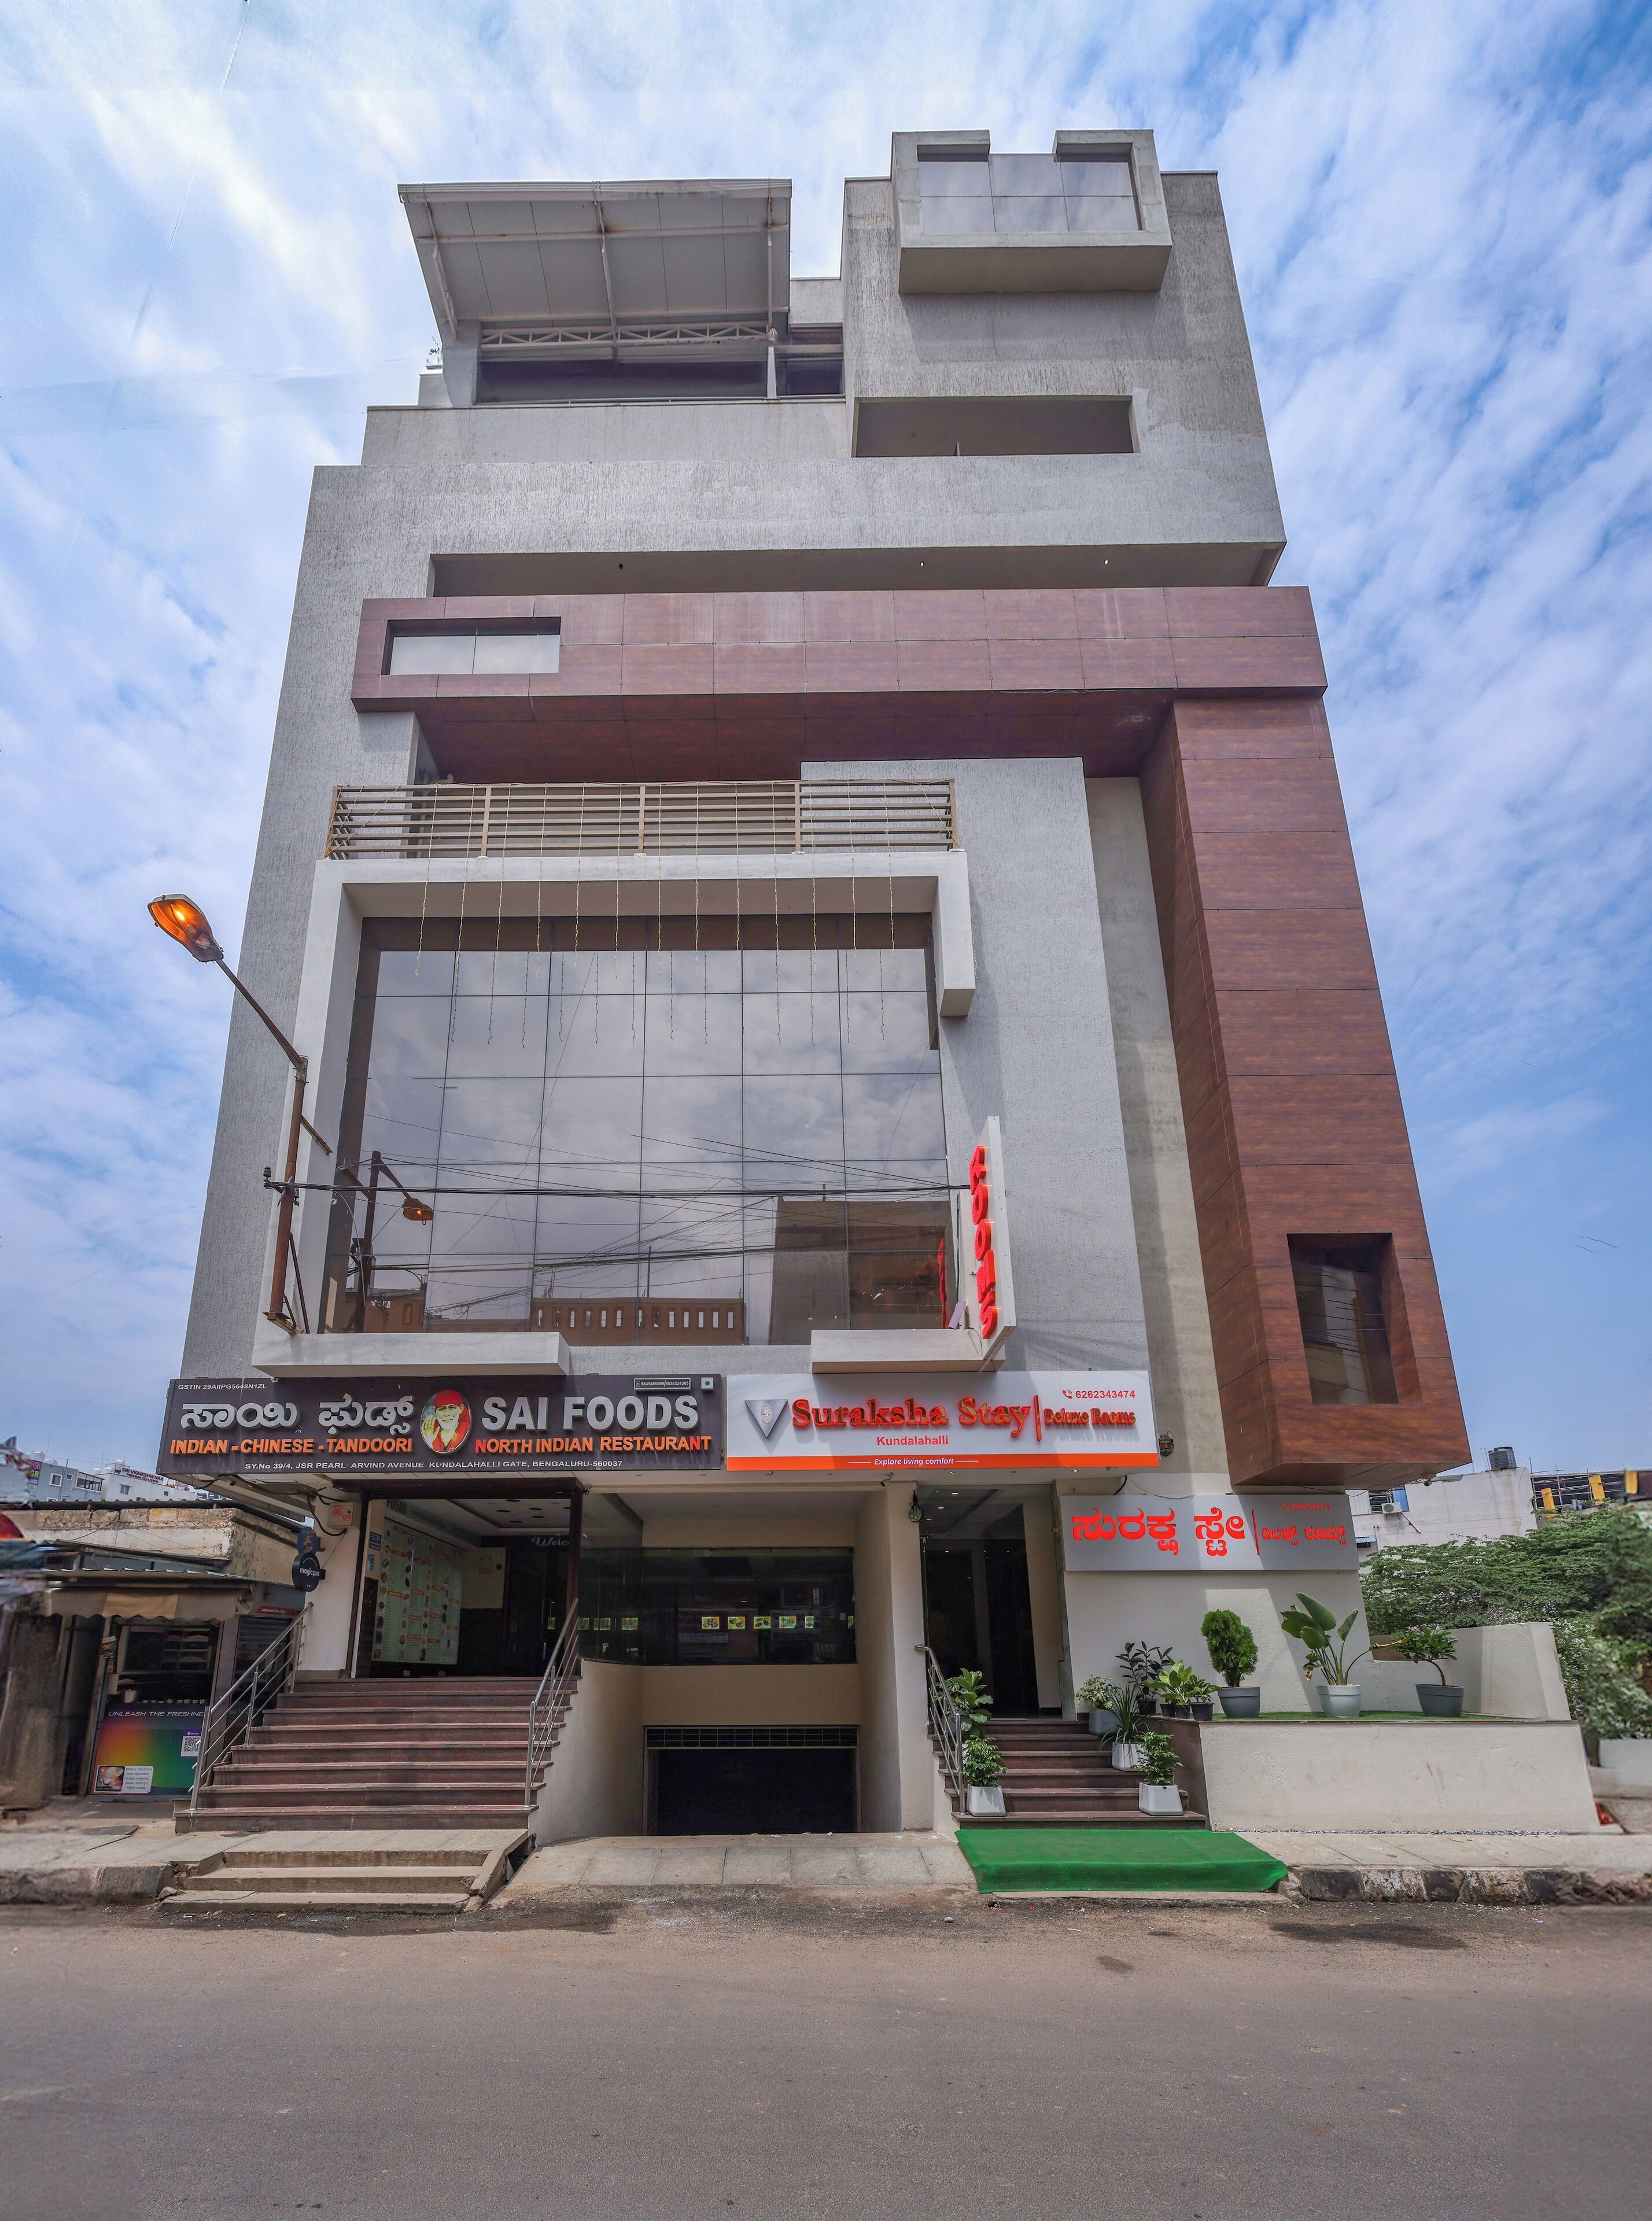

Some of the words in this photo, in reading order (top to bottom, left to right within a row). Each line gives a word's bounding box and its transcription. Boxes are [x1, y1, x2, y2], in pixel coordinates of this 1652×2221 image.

[969, 1145, 998, 1340] ROOMS
[1075, 1390, 1135, 1399] 6262343474
[180, 1402, 300, 1430] ಸಾಯಿ
[318, 1393, 414, 1436] ಫುಡ್ಸ್
[481, 1396, 549, 1432] SAI
[563, 1395, 699, 1432] FOODS
[792, 1397, 949, 1427] Suraksha
[958, 1397, 1031, 1438] Stay
[1043, 1407, 1090, 1425] Deluxe
[1090, 1407, 1136, 1425] Rooms
[170, 1439, 228, 1454] INDIAN
[240, 1438, 314, 1453] CHINESE
[325, 1438, 412, 1452] TANDOORI
[475, 1438, 532, 1454] NORTH
[536, 1437, 593, 1453] INDIAN
[600, 1436, 711, 1452] RESTAURANT
[877, 1436, 949, 1445] Kundalahalli
[904, 1458, 923, 1466] living
[925, 1457, 954, 1465] comfort
[531, 1533, 570, 1546] Welc
[1071, 1507, 1179, 1556] ಸುರಕ್ಷ
[1194, 1507, 1245, 1557] ಸ್ಟೇ
[300, 1567, 319, 1577] magicpin
